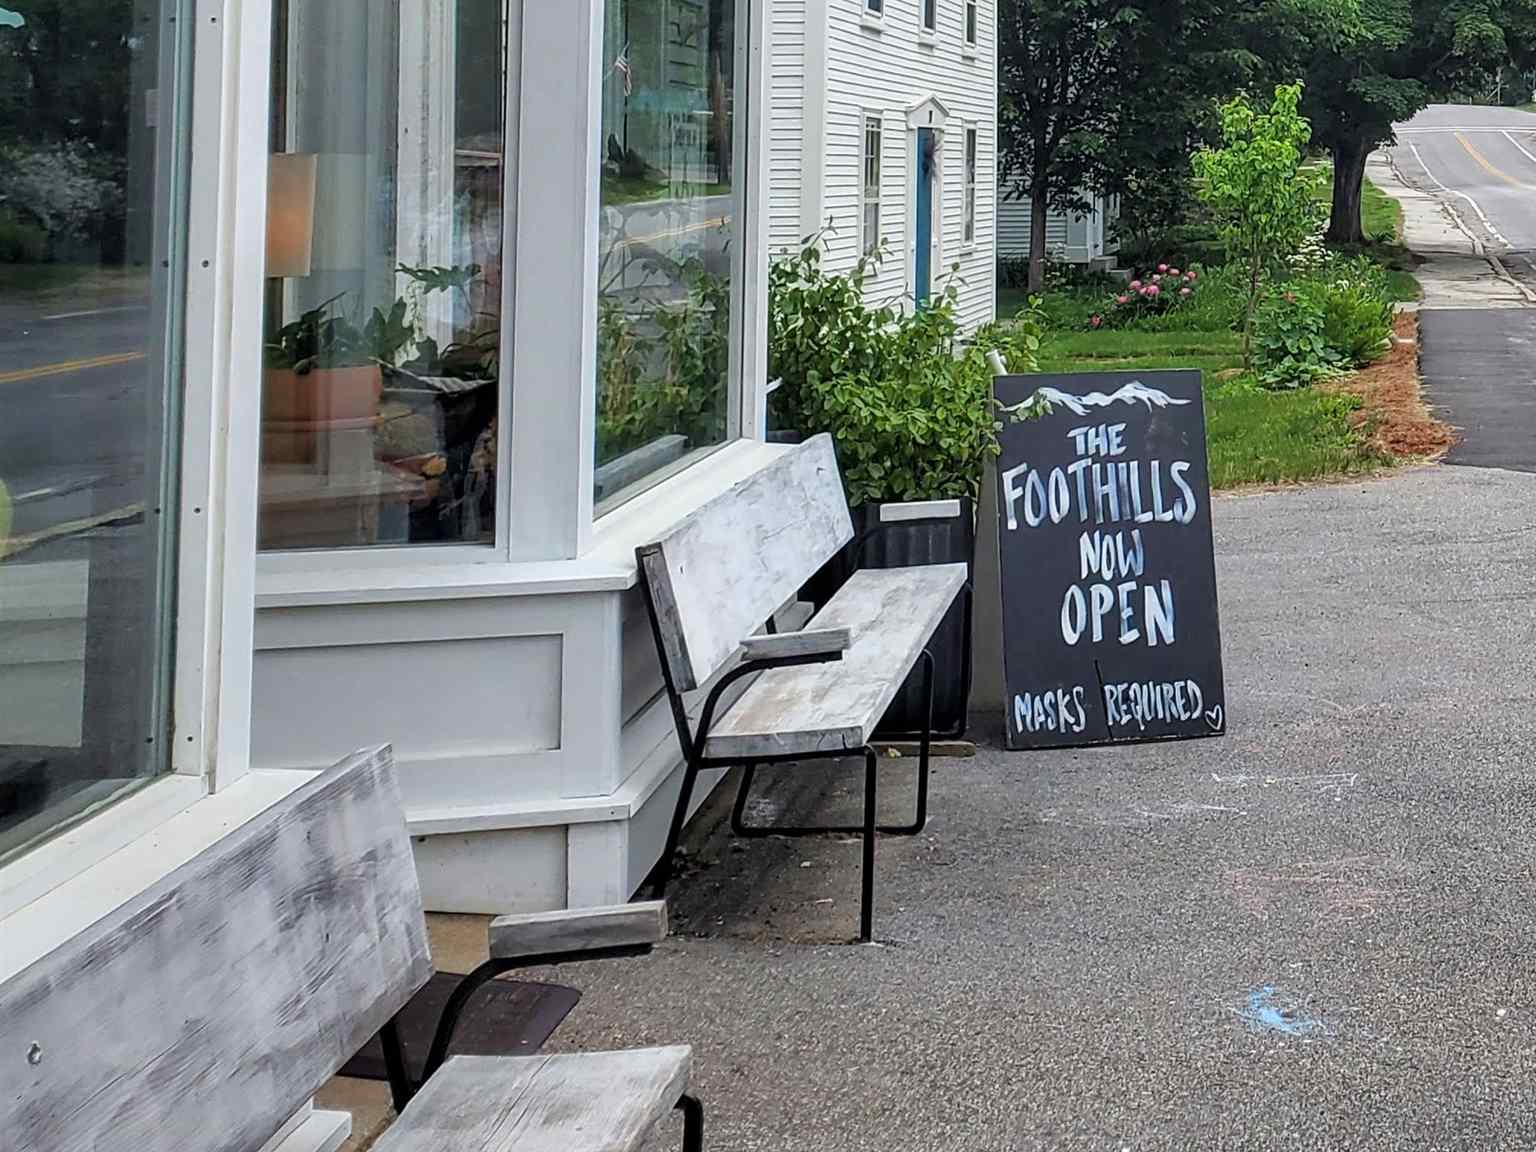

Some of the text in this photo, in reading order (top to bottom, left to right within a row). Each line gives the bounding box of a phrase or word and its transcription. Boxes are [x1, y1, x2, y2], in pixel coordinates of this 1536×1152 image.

[1067, 422, 1127, 456] THE
[1001, 459, 1198, 530] FOOTHILLS
[1079, 529, 1144, 580] NOW
[1060, 579, 1176, 647] OPEN
[1014, 678, 1203, 734] MASKS REQUIRED
